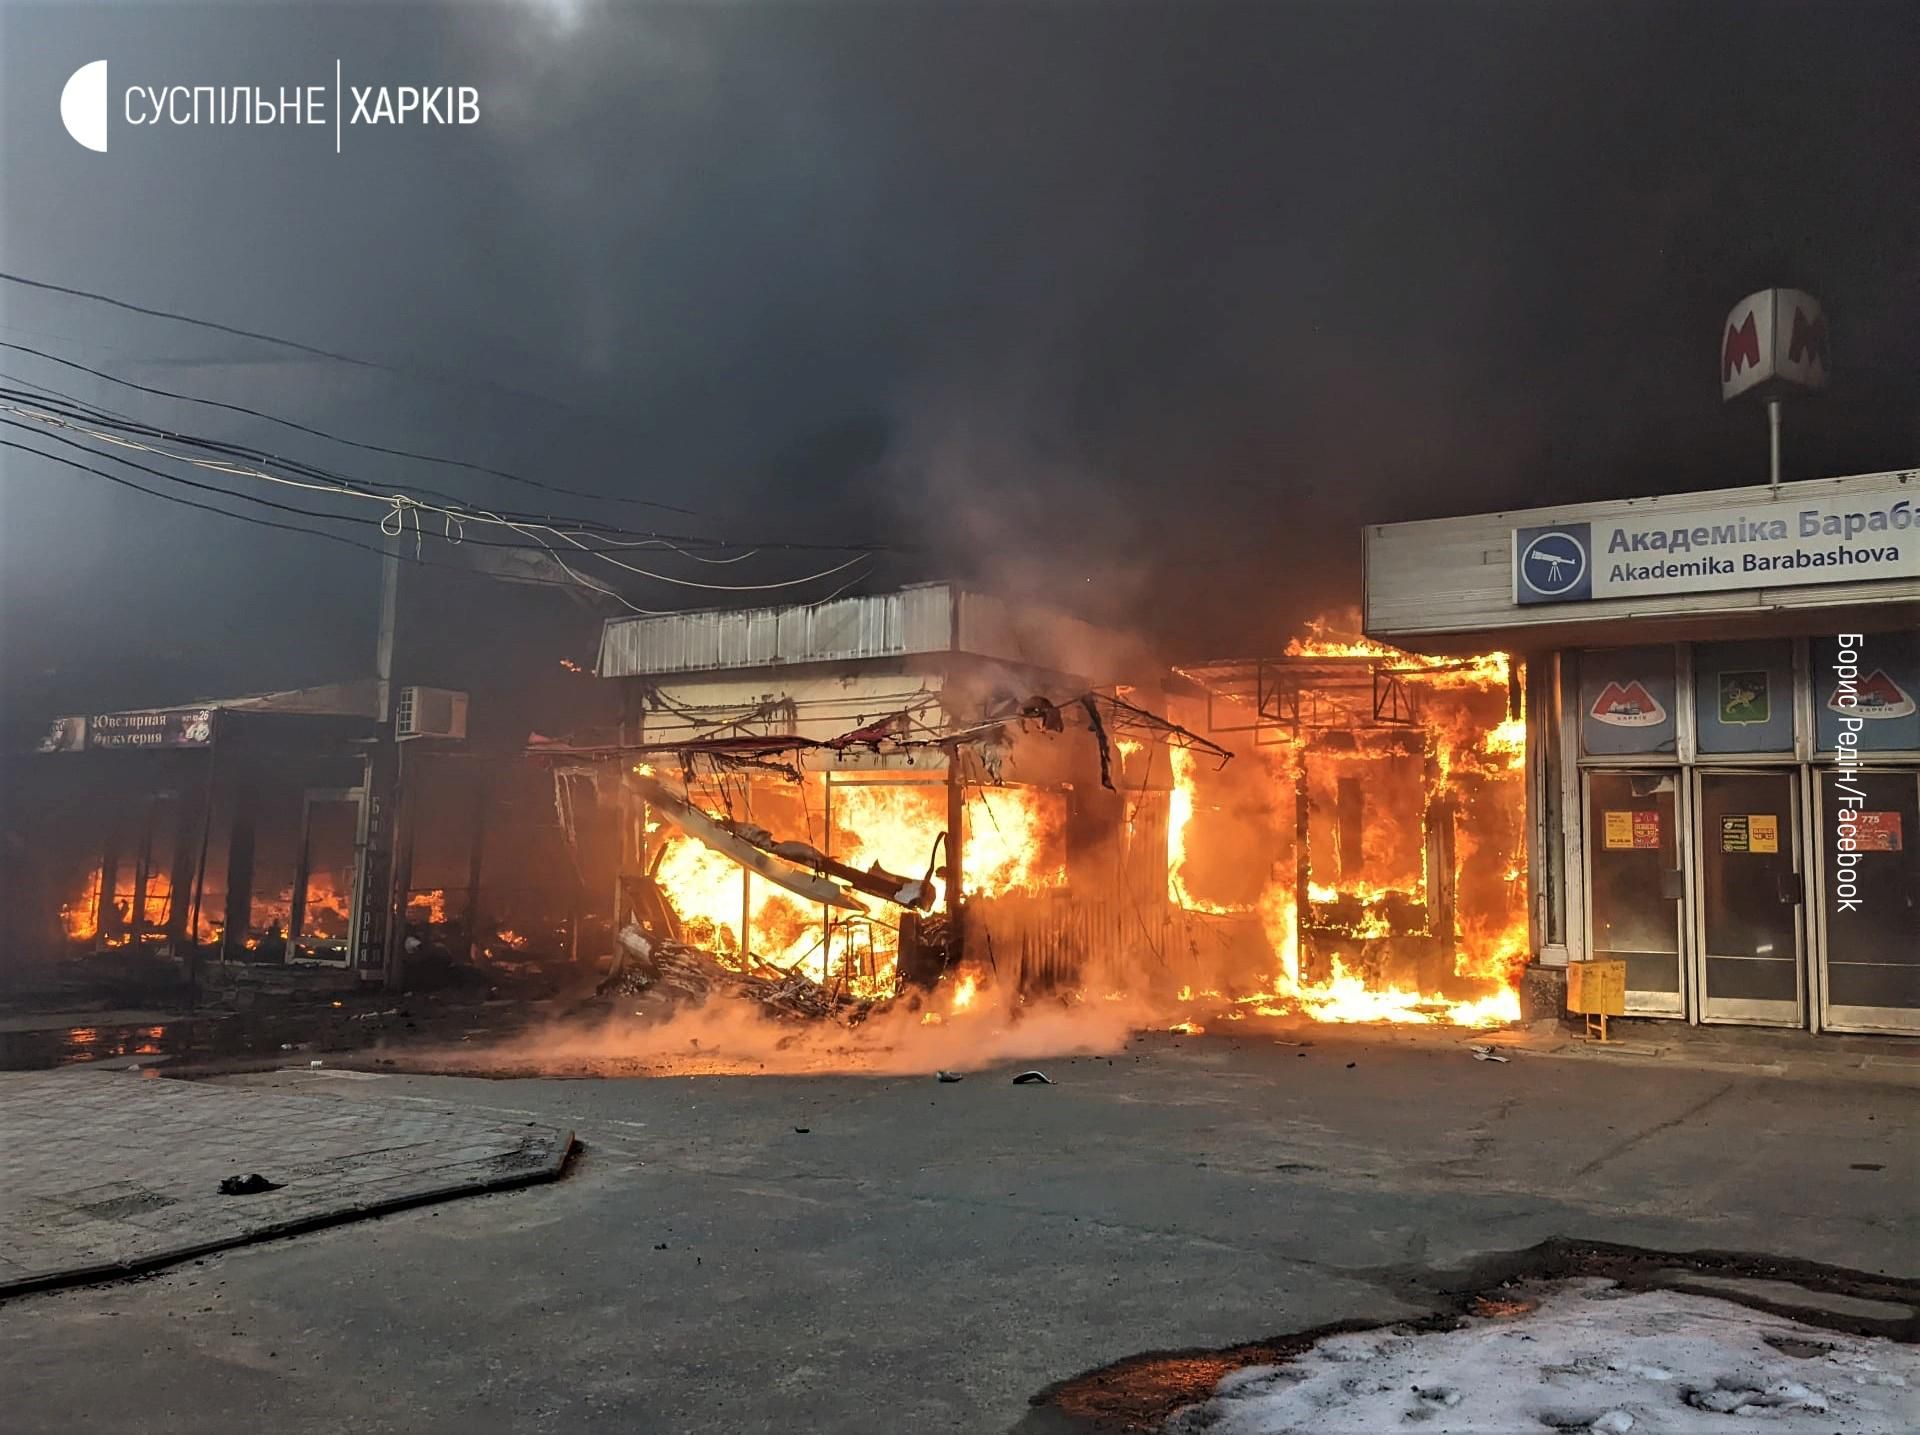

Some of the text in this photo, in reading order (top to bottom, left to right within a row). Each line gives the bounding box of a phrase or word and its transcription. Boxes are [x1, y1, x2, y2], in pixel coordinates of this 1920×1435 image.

[1608, 517, 1788, 554] Академіка
[1609, 545, 1899, 583] Akademika Barabashova
